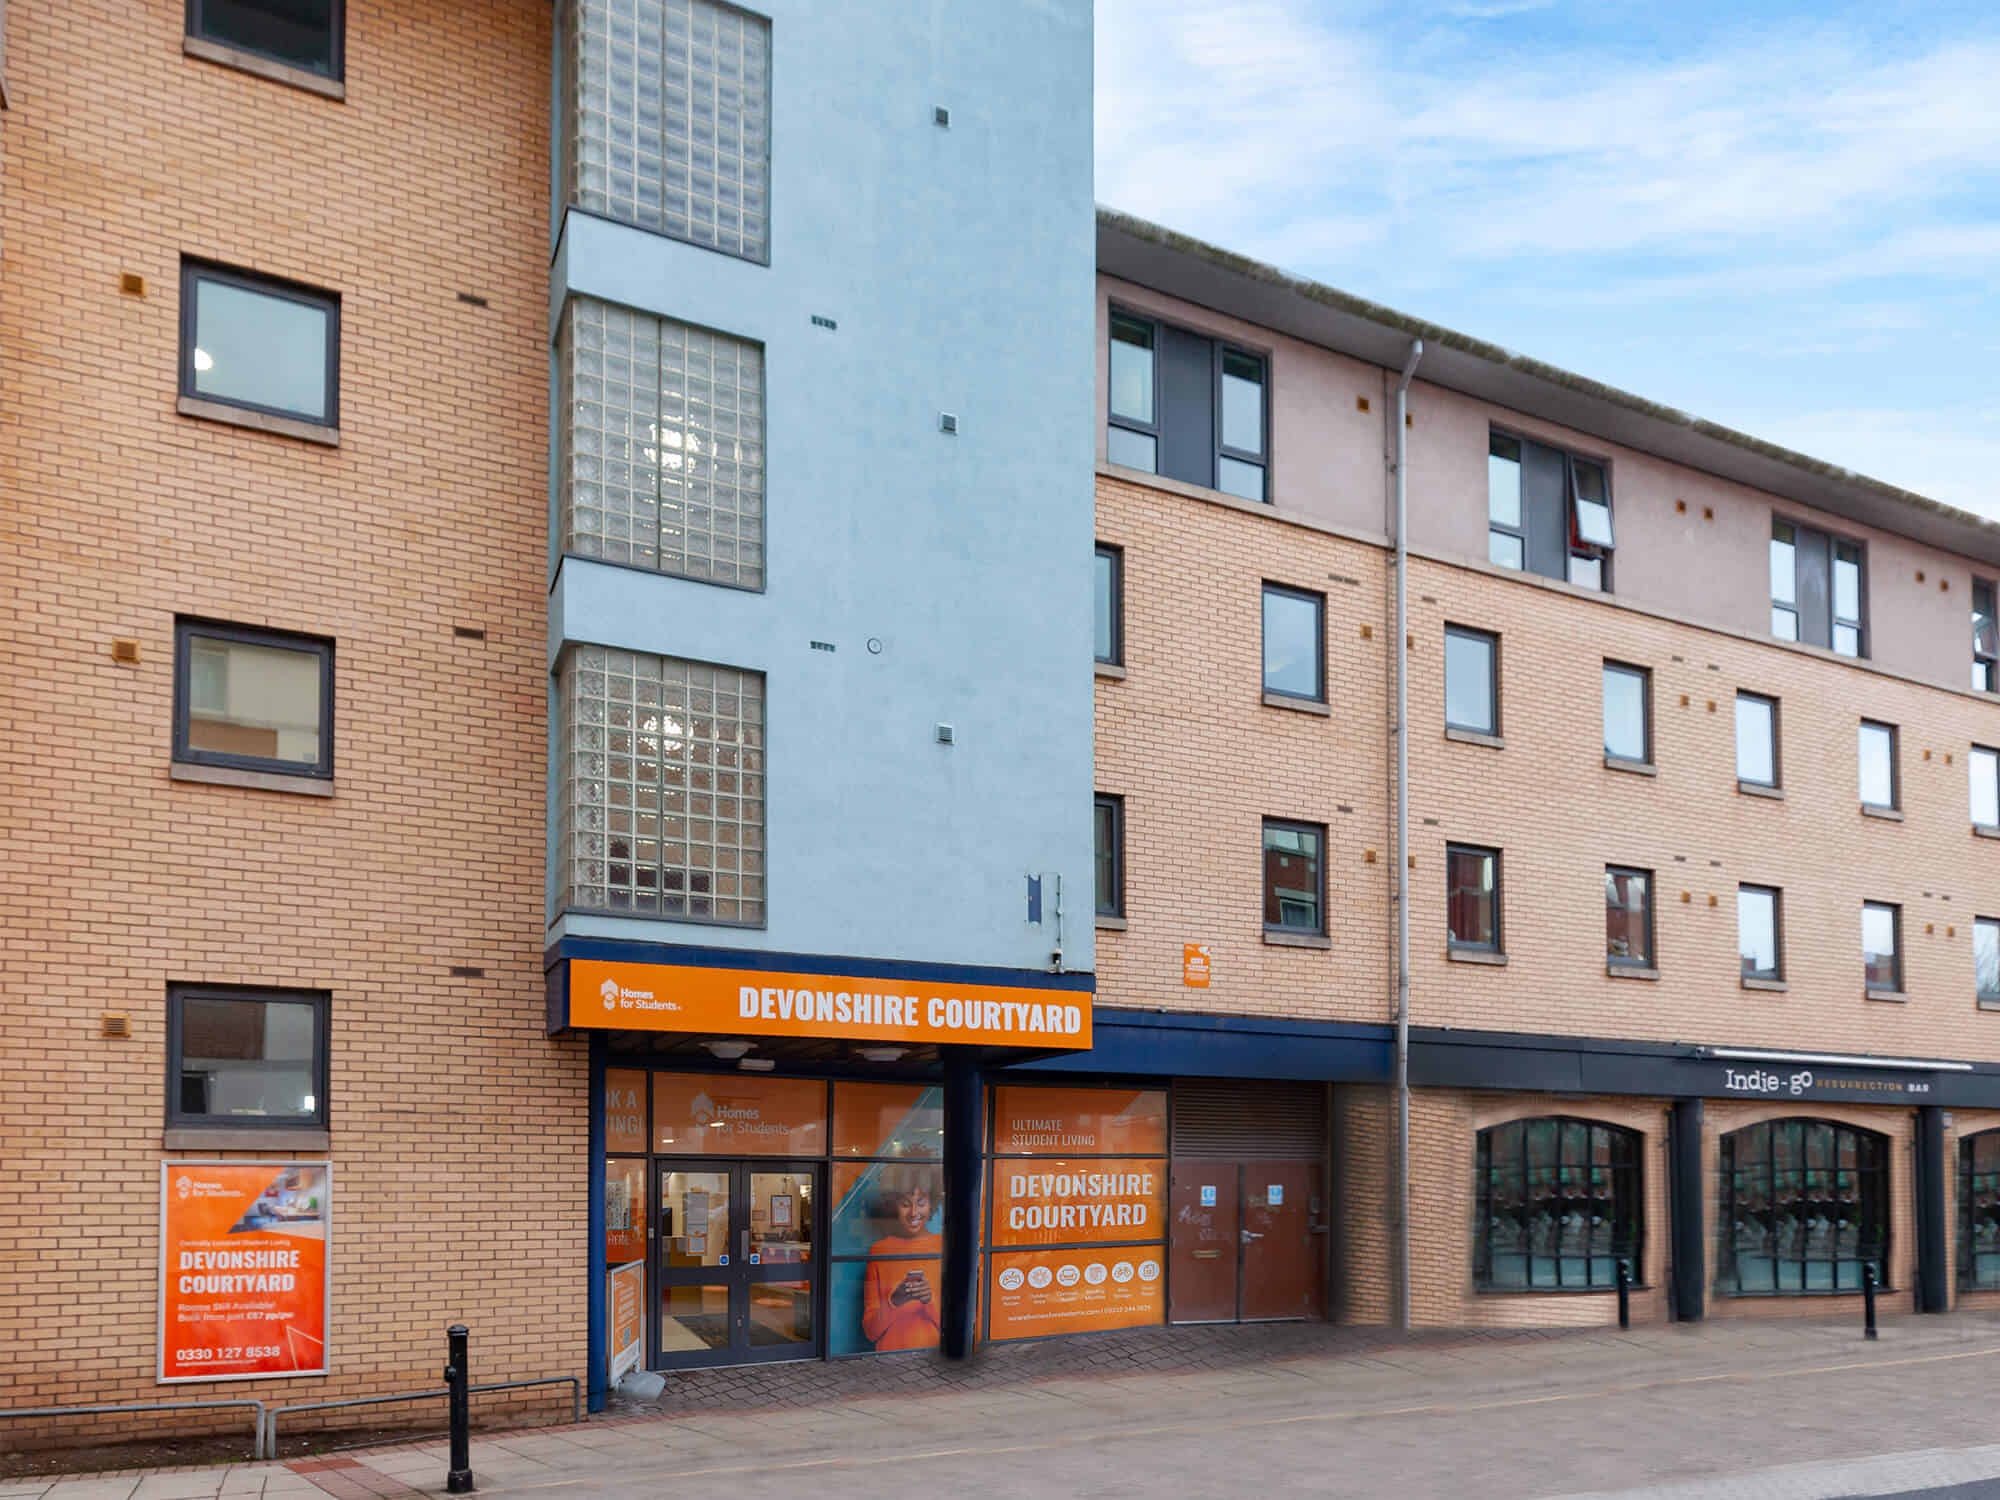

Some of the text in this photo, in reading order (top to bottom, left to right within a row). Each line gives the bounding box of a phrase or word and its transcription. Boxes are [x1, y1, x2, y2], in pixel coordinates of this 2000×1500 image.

[621, 988, 653, 999] Homes
[621, 1000, 678, 1011] for Students
[739, 986, 1081, 1035] DEVONSHIRE COURTYARD
[1725, 1069, 1929, 1095] Indie-go RESURRECTION BAR
[626, 1090, 637, 1109] A
[717, 1105, 760, 1120] Homes
[737, 1120, 787, 1136] Students
[1012, 1119, 1062, 1131] ULTIMATE
[1012, 1134, 1096, 1146] STUDENT LIVING
[1010, 1173, 1153, 1198] DEVONSHIRE
[1010, 1203, 1147, 1229] COURTYARD
[180, 1250, 300, 1270] DEVONSHIRE
[179, 1274, 296, 1294] COURTYARD
[176, 1345, 281, 1361] 0330 127 8538
